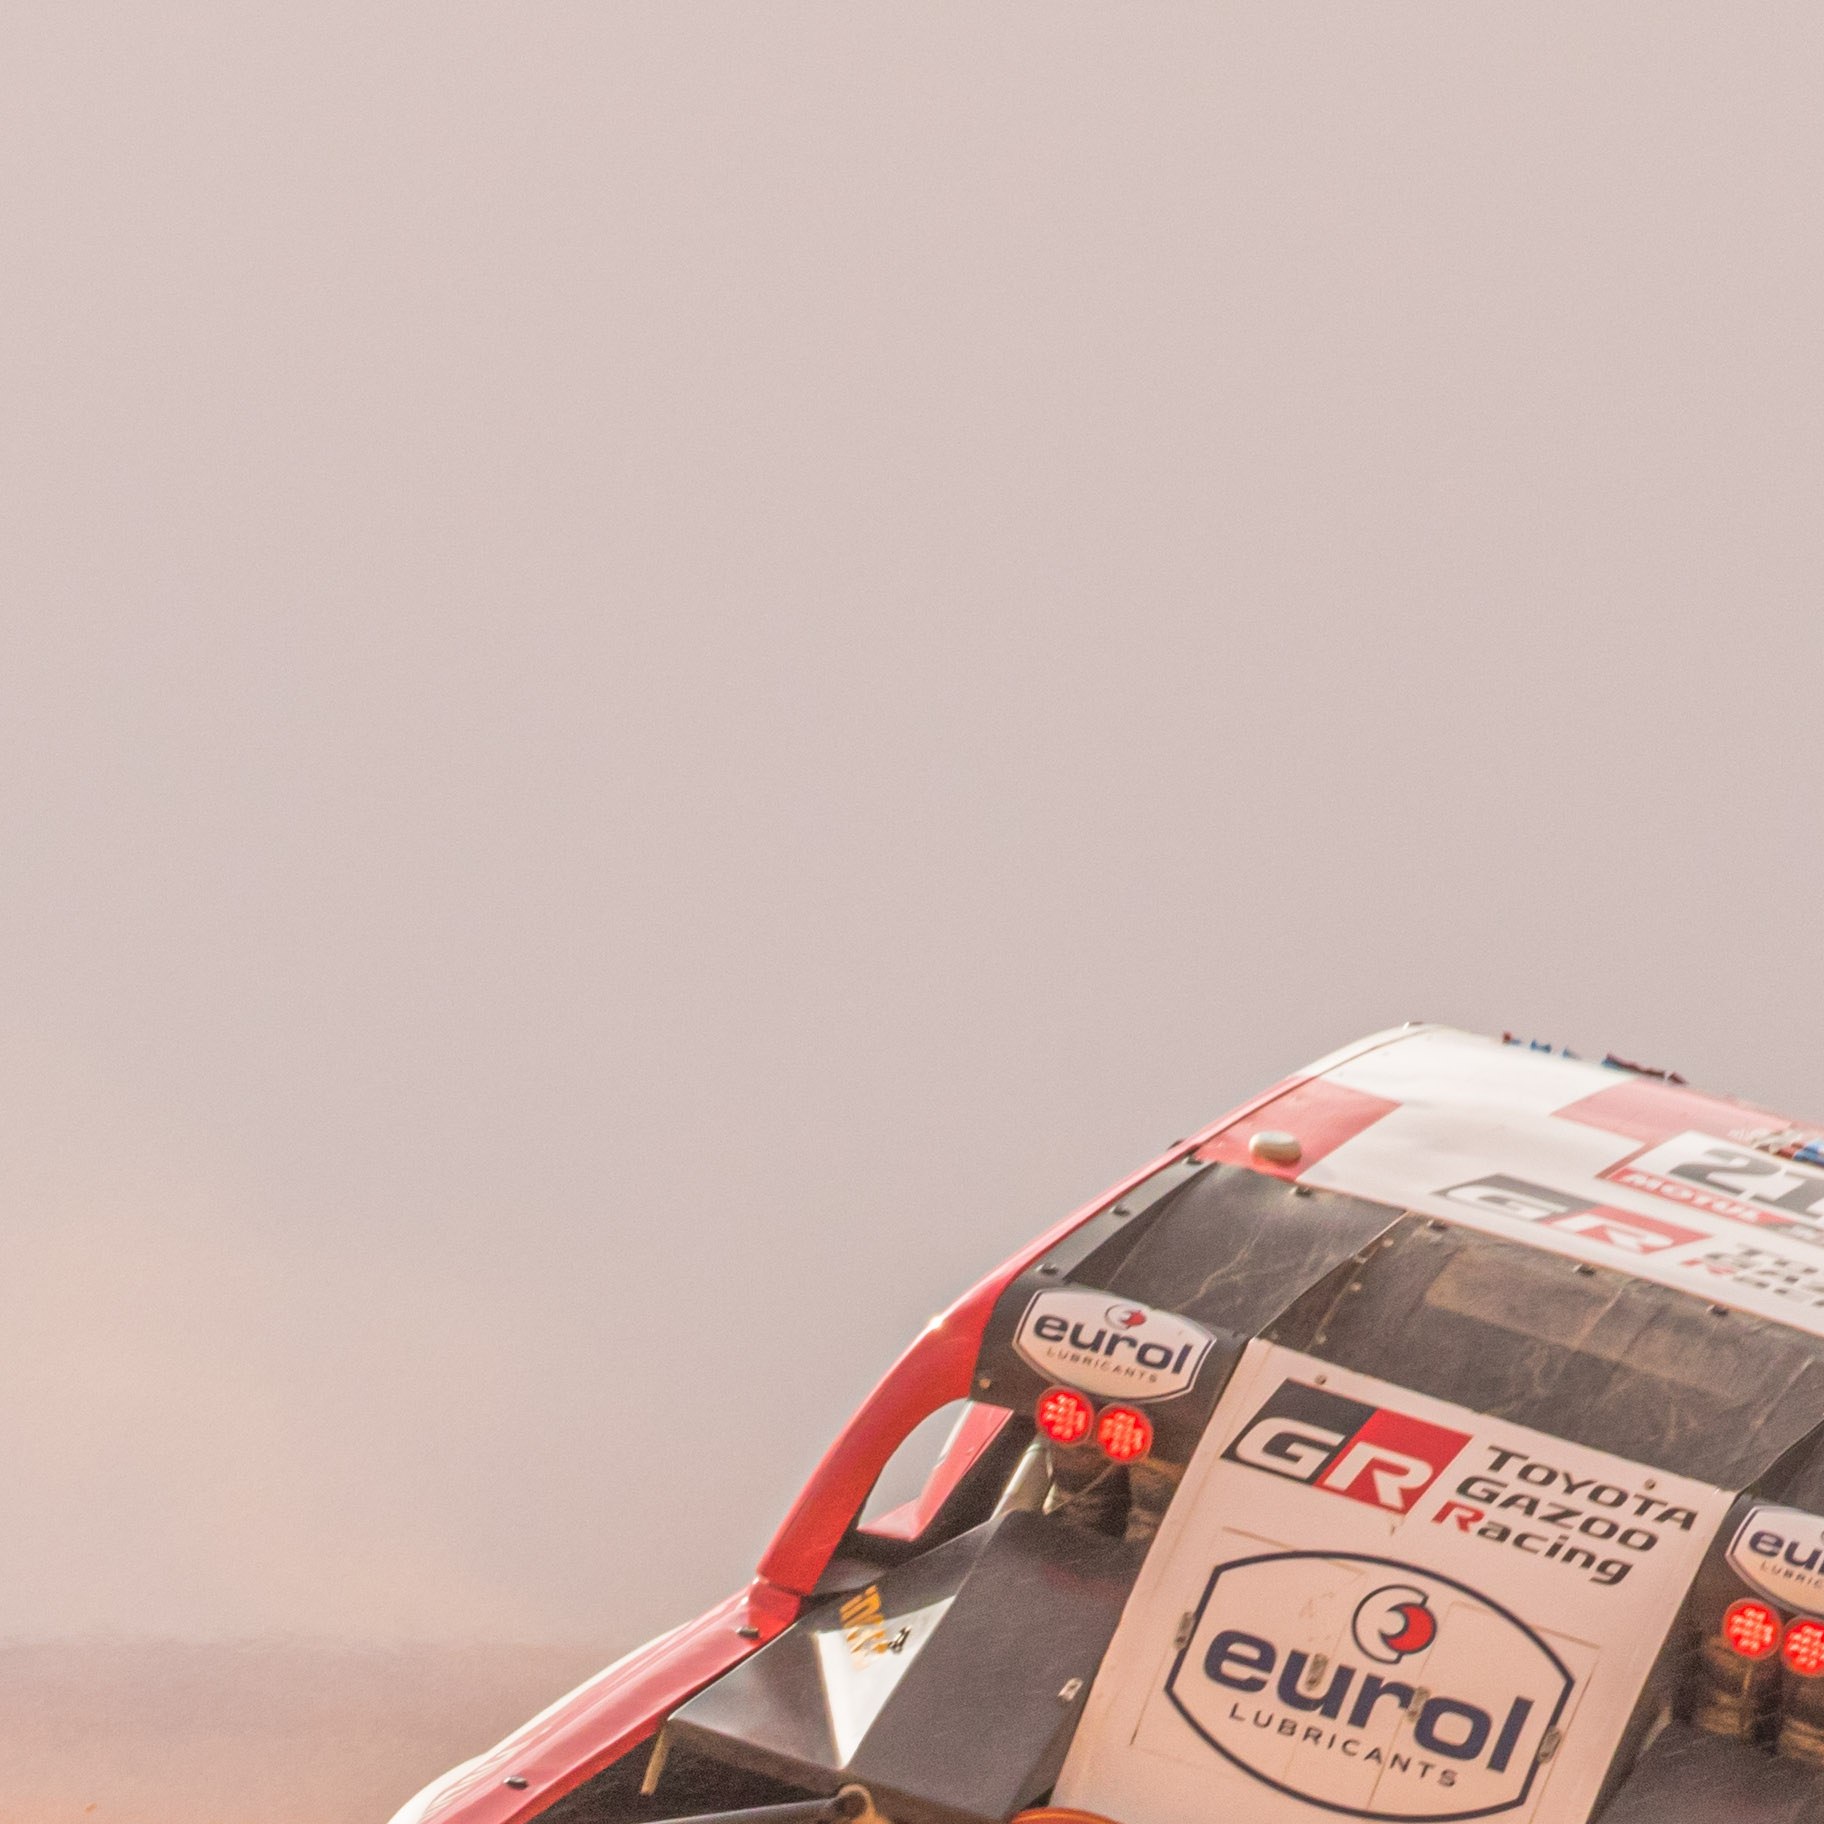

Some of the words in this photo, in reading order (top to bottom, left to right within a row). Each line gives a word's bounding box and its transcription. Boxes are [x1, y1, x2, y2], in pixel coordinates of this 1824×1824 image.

[1444, 1182, 1676, 1254] GR
[1033, 1314, 1194, 1375] eurol
[1046, 1345, 1159, 1383] LUBRICANTS
[1234, 1416, 1434, 1512] GR
[1486, 1444, 1700, 1533] TOYOTA
[1430, 1500, 1635, 1587] Racing
[1454, 1475, 1660, 1553] GAZOO
[1202, 1628, 1536, 1773] eurol
[1228, 1702, 1458, 1789] LUBRICANTS
